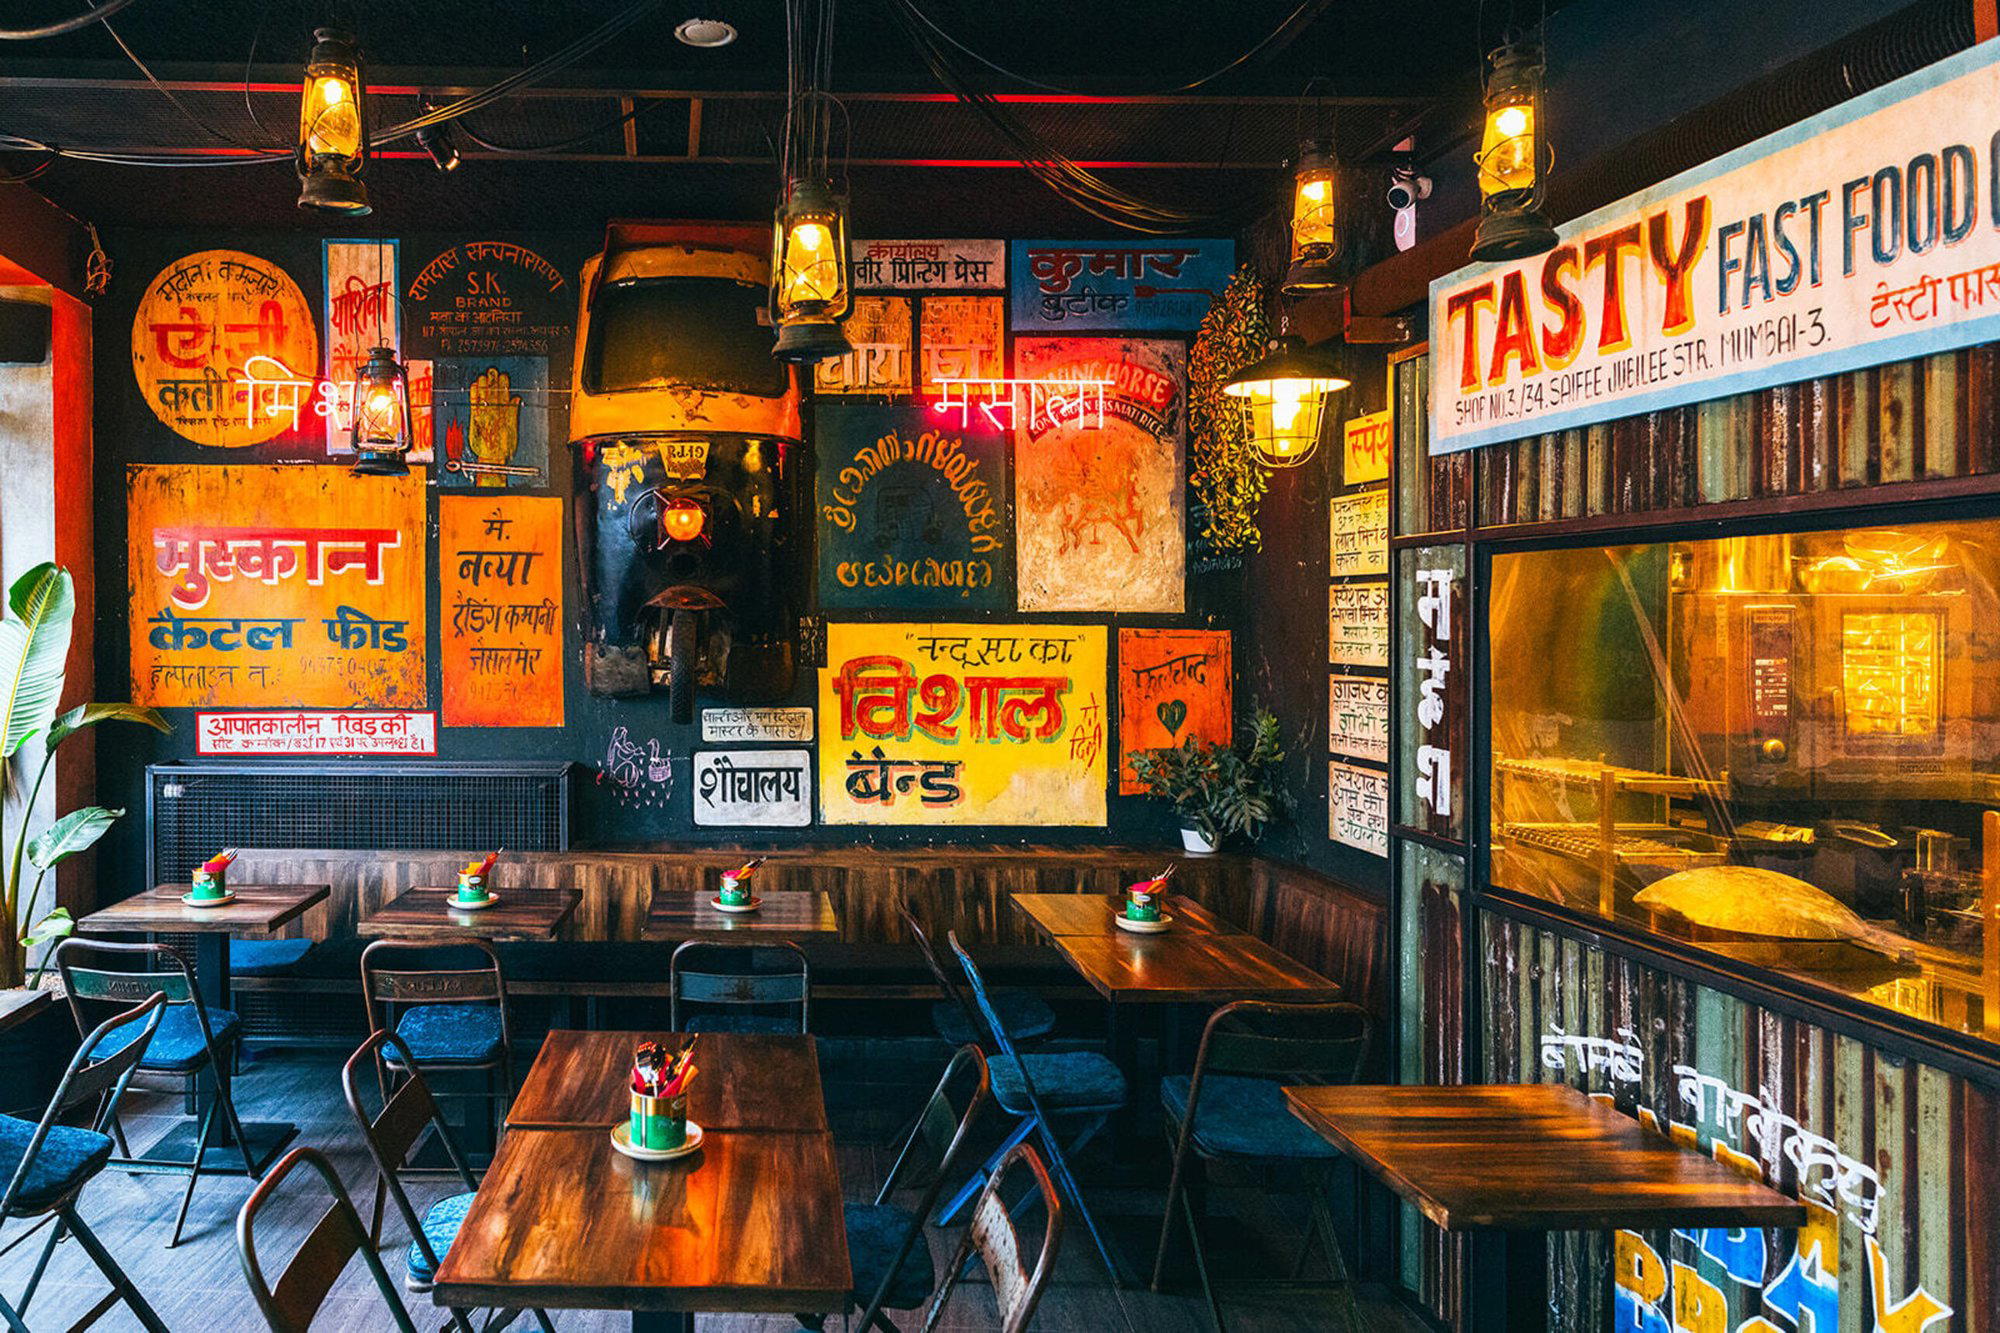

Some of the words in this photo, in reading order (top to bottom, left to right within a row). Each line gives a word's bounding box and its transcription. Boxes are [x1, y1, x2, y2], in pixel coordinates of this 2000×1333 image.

[467, 271, 507, 296] S.K.
[953, 254, 993, 284] प्रेस
[1027, 248, 1201, 294] कुमार
[1448, 195, 1712, 396] TASTY
[1719, 189, 1831, 317] FAST
[1842, 143, 1979, 278] FOOD
[455, 296, 513, 309] BRAND
[930, 374, 1117, 433] मसाला
[1105, 362, 1171, 404] HORSE
[153, 527, 402, 611] मुस्कान
[147, 606, 306, 651] कैटल
[321, 604, 410, 653] फीड
[832, 655, 1073, 745] विशाल
[207, 714, 323, 735] आपातकालीन
[699, 755, 804, 809] शौचालय
